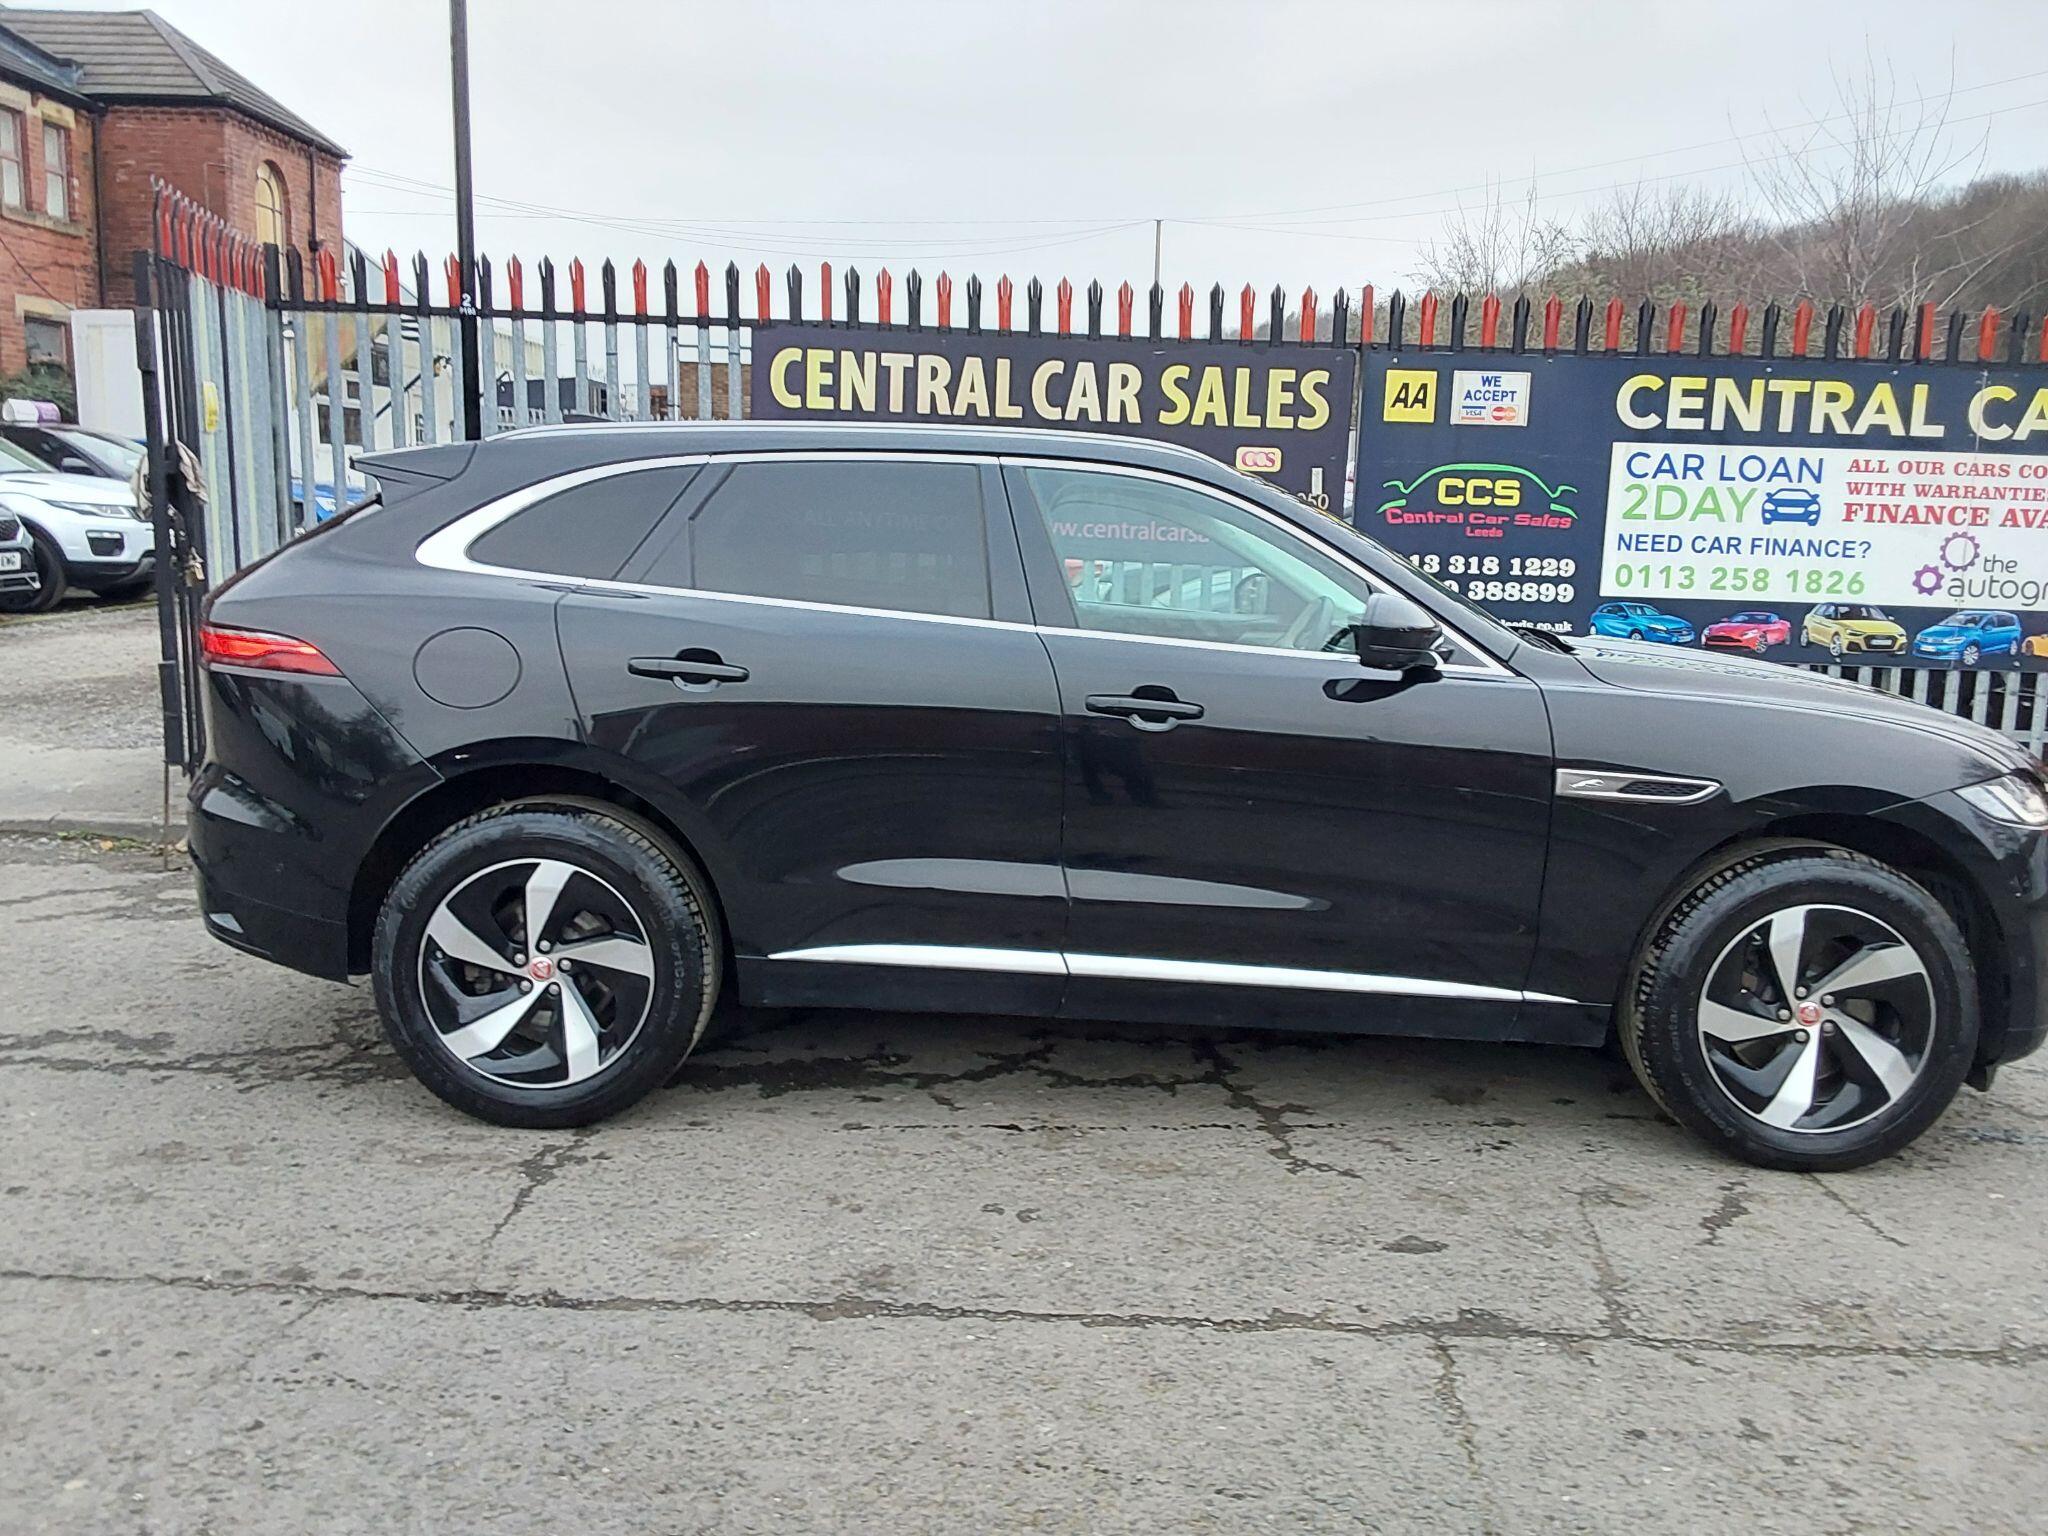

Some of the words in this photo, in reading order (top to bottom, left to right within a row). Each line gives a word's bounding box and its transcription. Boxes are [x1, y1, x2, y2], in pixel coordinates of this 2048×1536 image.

[769, 347, 1023, 419] CENTRAL
[1031, 359, 1142, 424] CAR
[1158, 364, 1330, 431] SALES
[1481, 375, 1502, 388] WE
[1391, 382, 1428, 409] AA
[1463, 389, 1518, 402] ACCEPT
[1616, 374, 1945, 438] CENTRAL
[1968, 385, 2048, 441] CA
[1626, 451, 1705, 481] CAR
[1719, 454, 1824, 484] LOAN
[1847, 459, 1890, 473] ALL
[1897, 460, 1945, 476] OUR
[1953, 462, 2011, 478] CARS
[2018, 464, 2048, 479] CO
[1437, 477, 1521, 507] CCS
[1622, 483, 1758, 523] 2DAY
[1846, 481, 1906, 497] WITH
[1913, 483, 2048, 502] WARRANTIE
[1385, 508, 1464, 525] Central
[1468, 512, 1510, 526] Car
[1513, 513, 1573, 529] Sales
[1841, 502, 1990, 527] FINANCE
[1465, 526, 1504, 538] Leeds
[1617, 533, 1683, 553] NEED
[1691, 535, 1742, 555] CAR
[1750, 537, 1872, 559] FINANCE?
[1448, 554, 1500, 575] 318
[1509, 557, 1576, 577] 1229
[1983, 554, 2018, 574] the
[1615, 563, 1696, 590] 0113
[1709, 566, 1770, 592] 258
[1786, 569, 1865, 595] 1826
[1467, 580, 1576, 603] 388899
